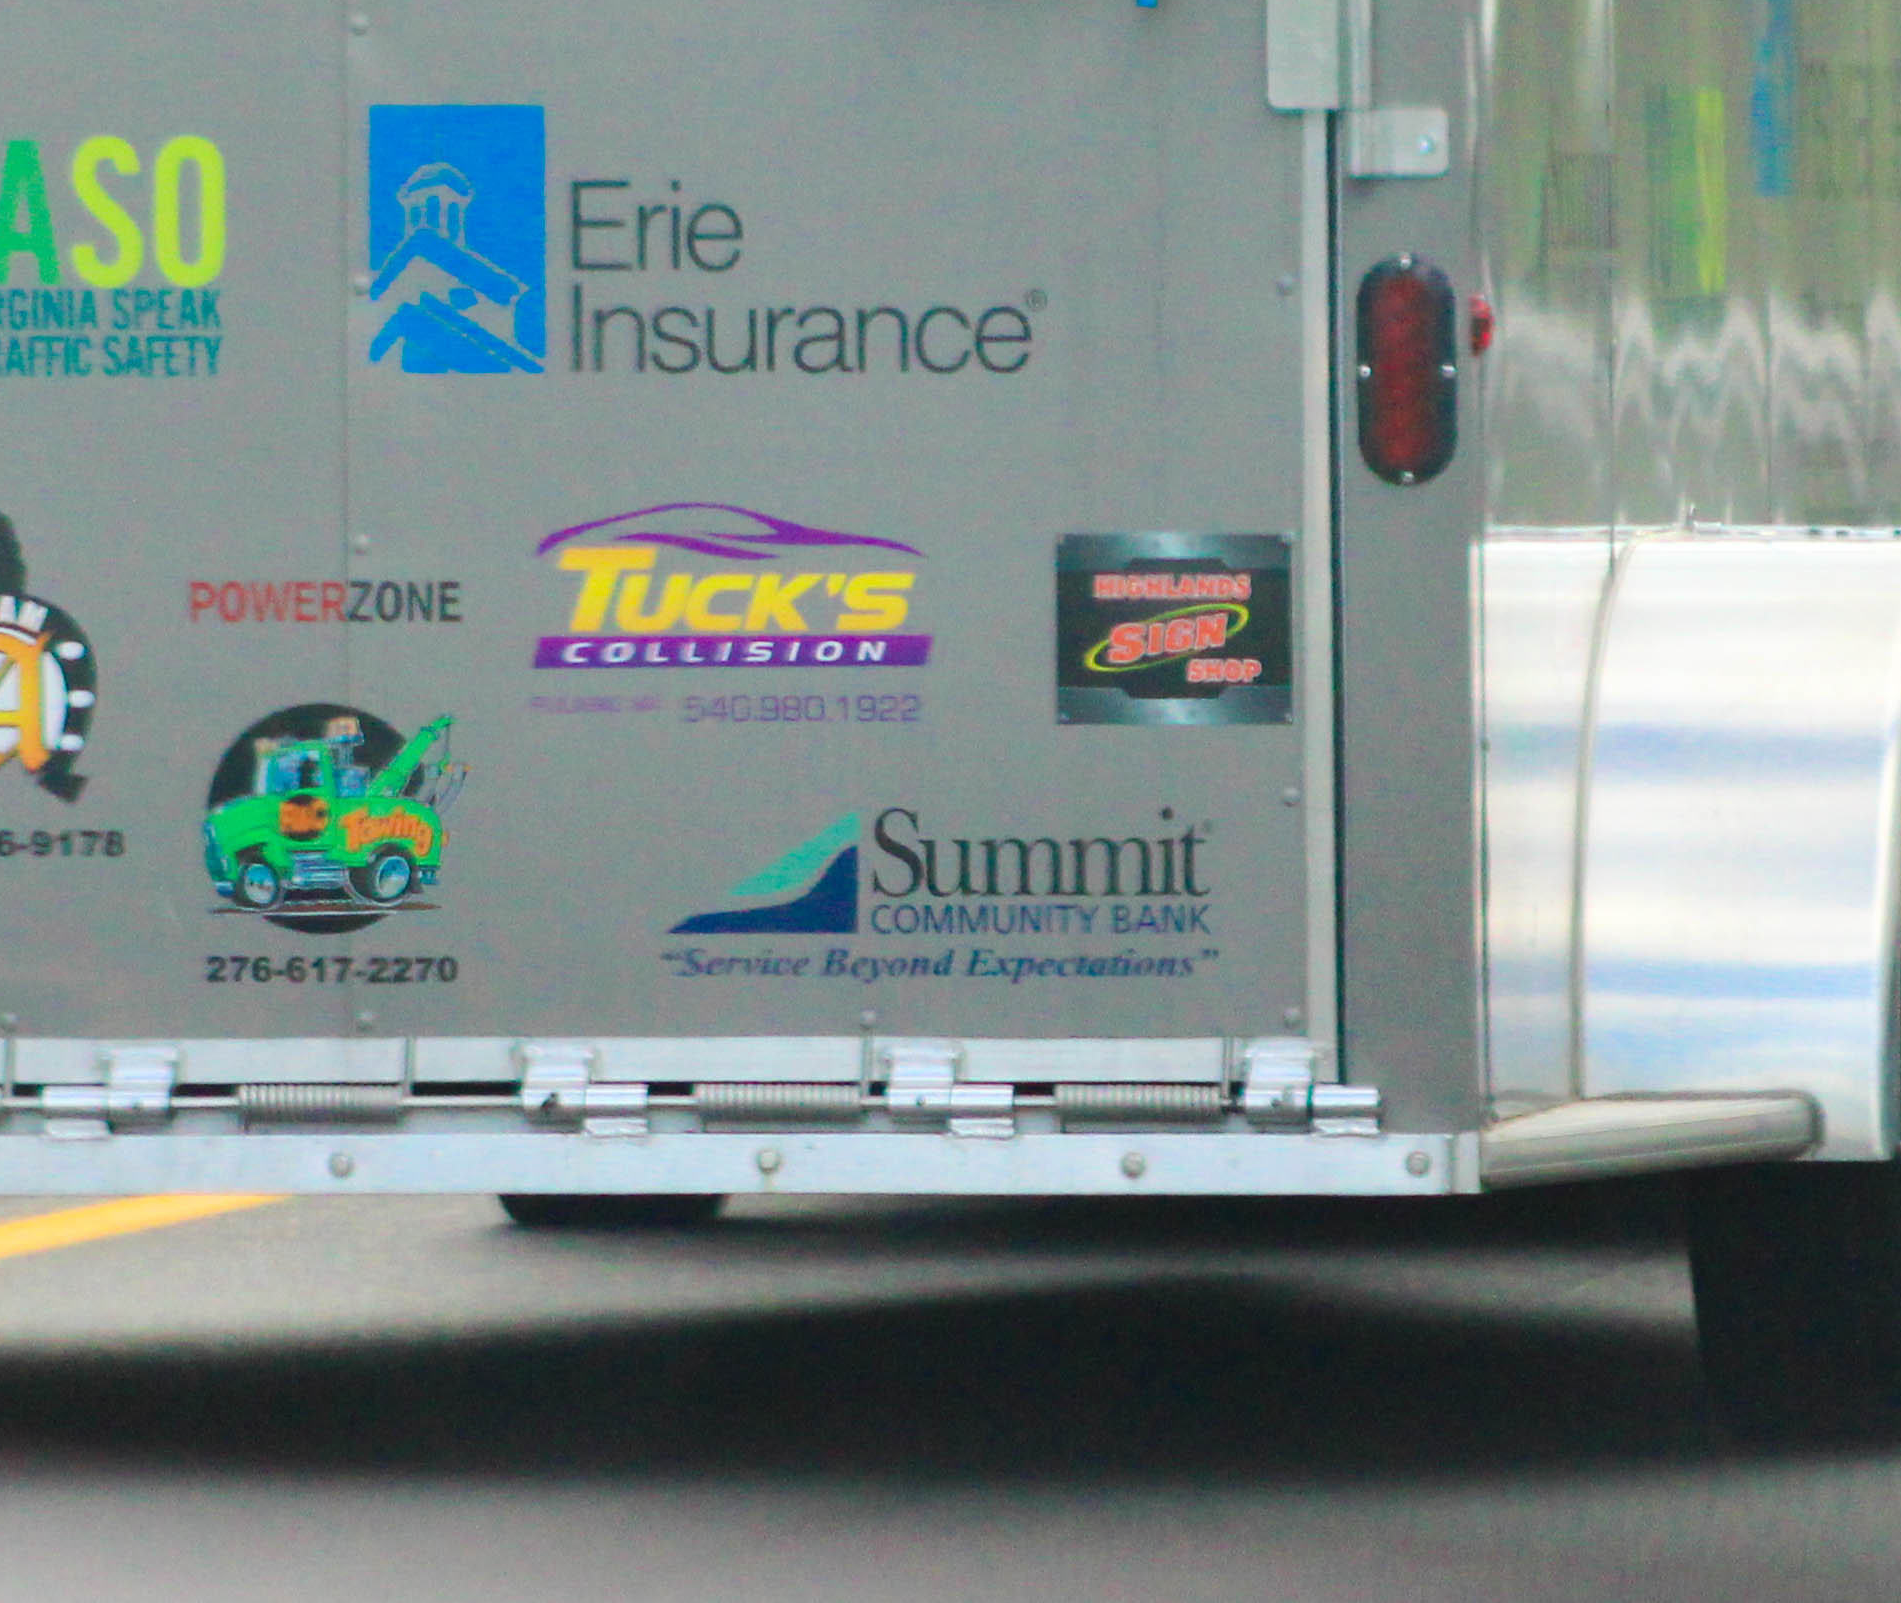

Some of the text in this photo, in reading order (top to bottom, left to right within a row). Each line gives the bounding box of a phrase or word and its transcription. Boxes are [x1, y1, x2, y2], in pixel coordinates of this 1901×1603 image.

[570, 178, 744, 274] Erie
[112, 289, 222, 331] SPEAK
[570, 282, 1034, 376] Insurance
[103, 333, 223, 376] SAFETY
[188, 580, 464, 624] POWERZONE
[556, 546, 916, 634] TUCK'S
[1093, 573, 1253, 601] HIGHLANDS
[560, 640, 888, 666] COLLISION
[1107, 612, 1230, 664] SIGN
[1186, 658, 1263, 683] SHOP
[684, 695, 924, 724] 540.980.1922
[340, 806, 432, 858] Towing
[872, 808, 1210, 898] Summit
[871, 904, 1213, 935] COMMUNITY BANK
[206, 956, 460, 984] 276-617-2270
[822, 948, 954, 984] Beyond
